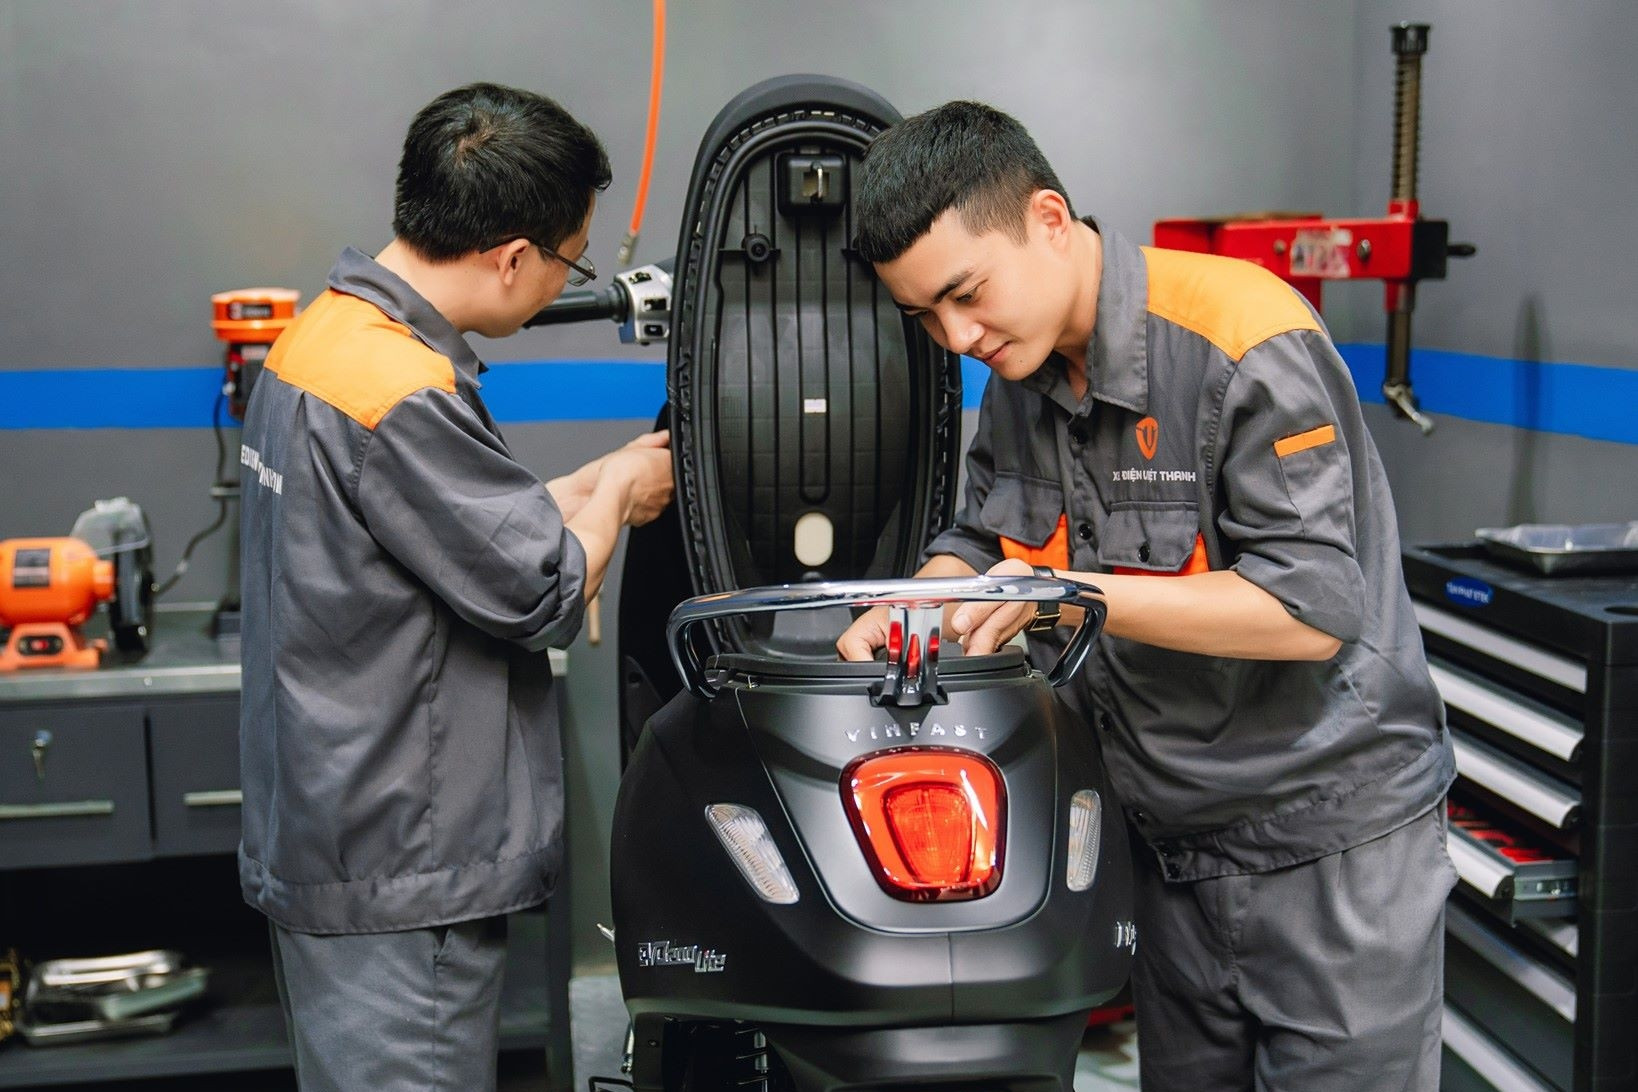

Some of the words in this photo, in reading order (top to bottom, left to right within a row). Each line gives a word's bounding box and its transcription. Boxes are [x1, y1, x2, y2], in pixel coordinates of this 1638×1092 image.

[1159, 470, 1196, 482] THANH
[844, 722, 988, 742] VINFAST
[695, 949, 727, 973] Lite
